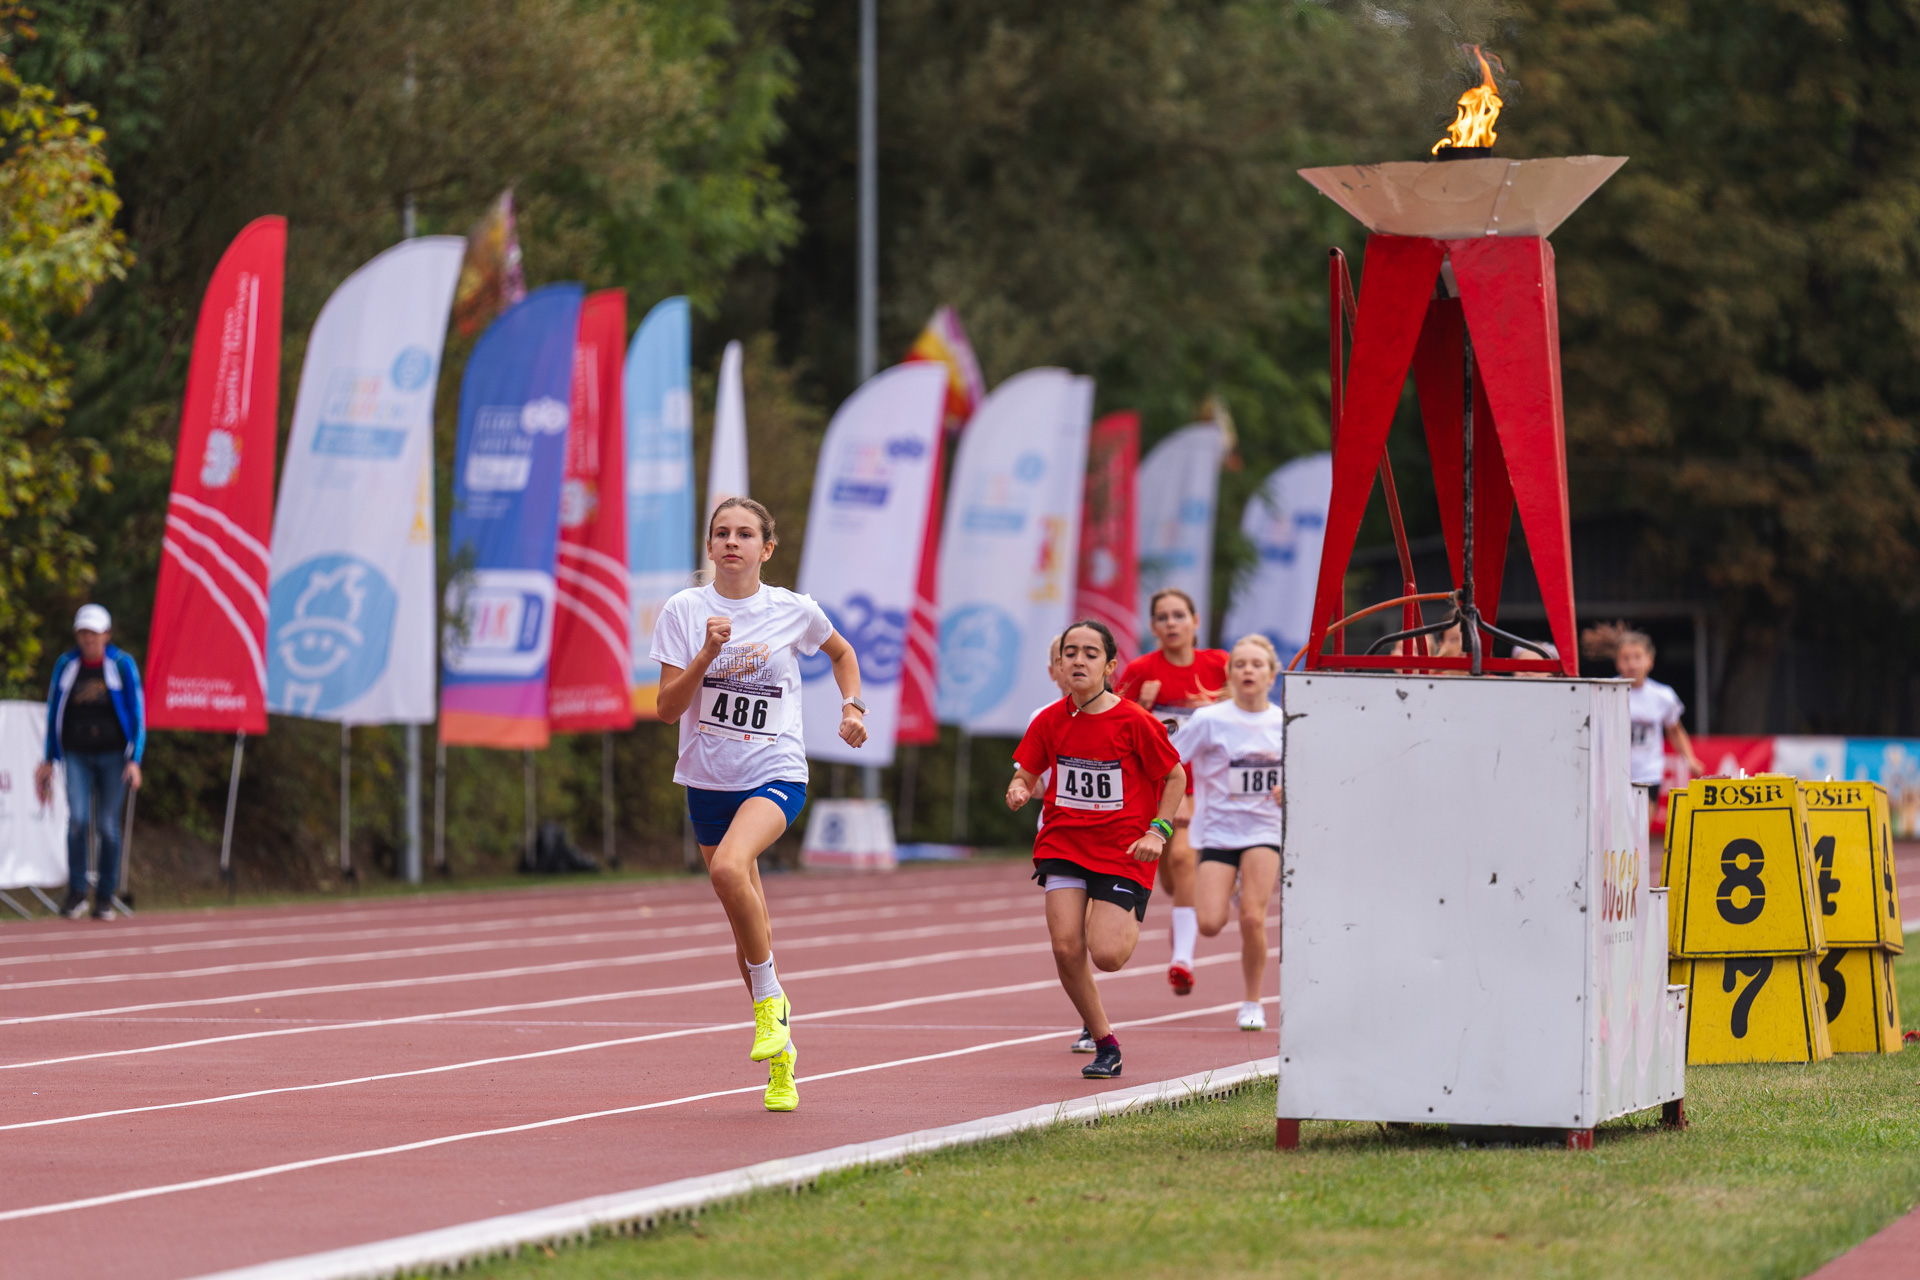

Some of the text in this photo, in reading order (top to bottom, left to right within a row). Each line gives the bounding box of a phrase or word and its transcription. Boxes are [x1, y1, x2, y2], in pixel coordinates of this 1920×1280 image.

[712, 652, 766, 671] Nadzieje
[711, 692, 768, 729] 486
[1065, 769, 1111, 799] 436
[1242, 770, 1278, 793] 186
[1704, 784, 1784, 806] BOSiR
[1805, 788, 1863, 806] OSiR
[1716, 838, 1766, 925] 8
[1722, 957, 1774, 1039] 7
